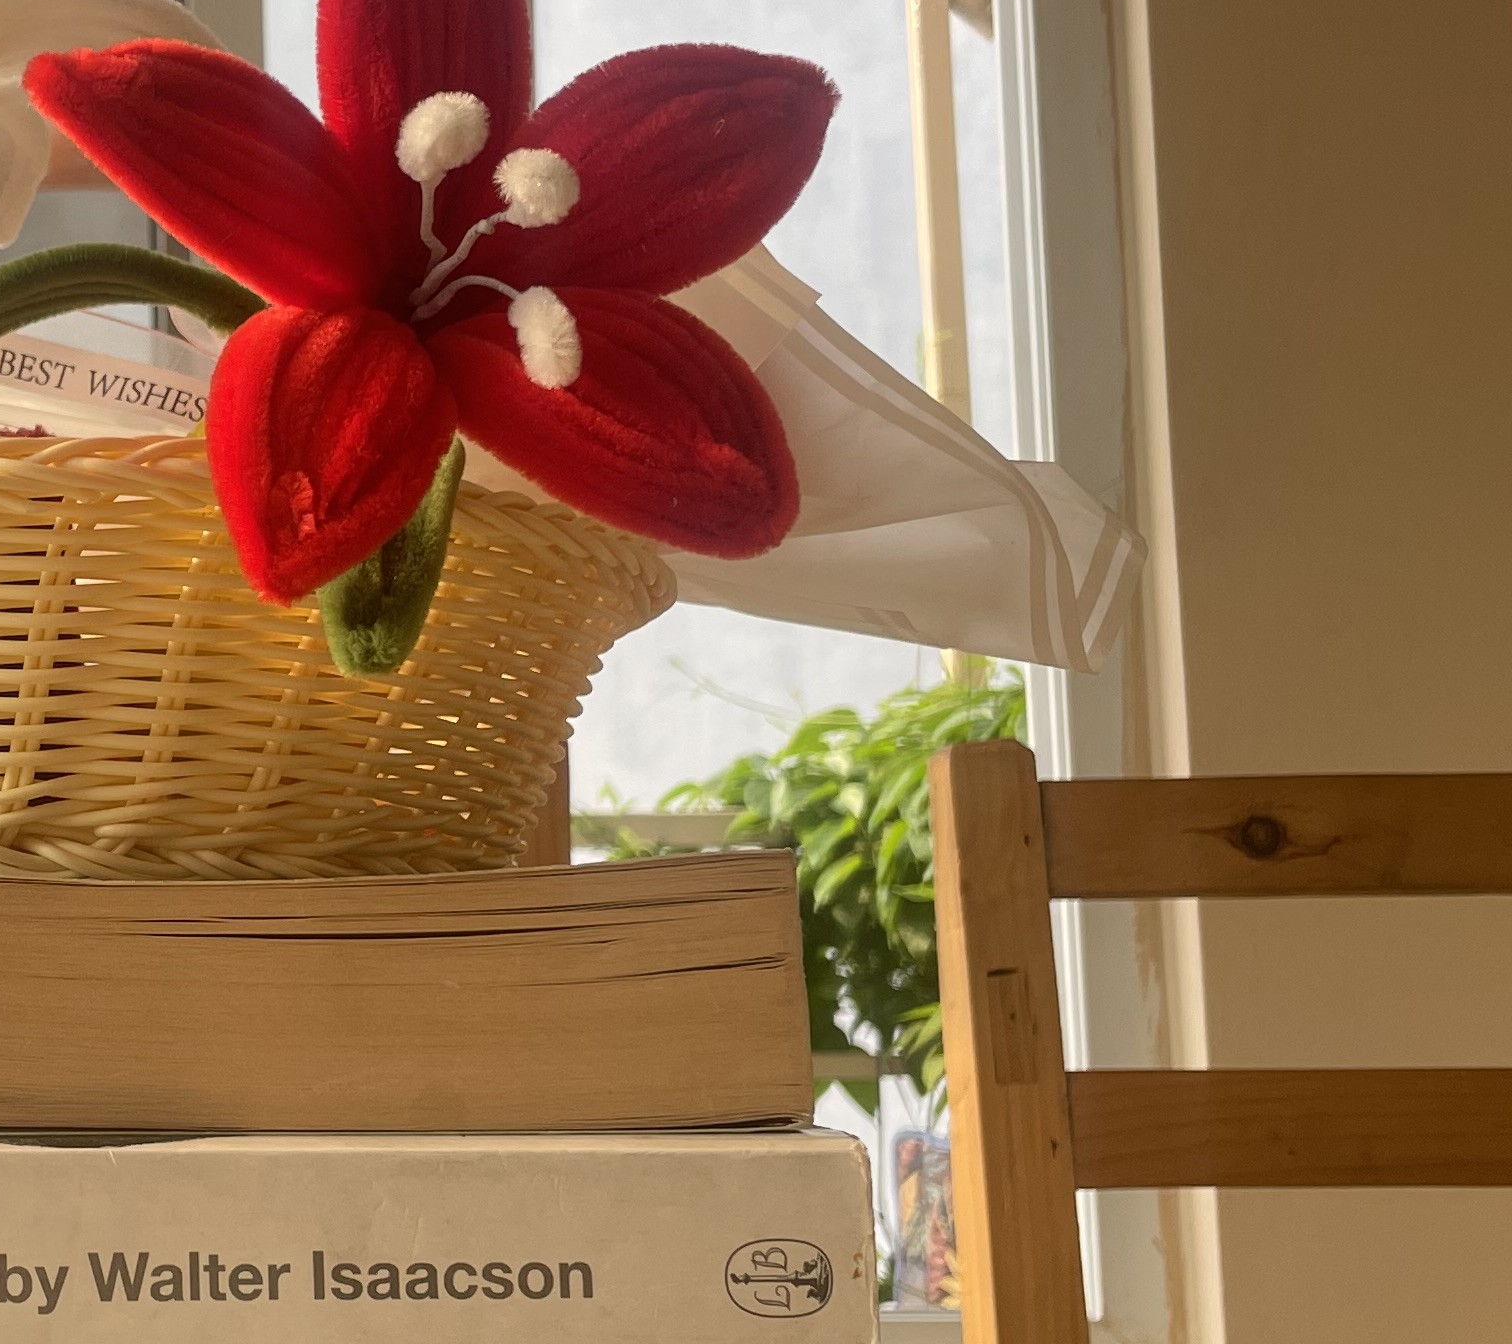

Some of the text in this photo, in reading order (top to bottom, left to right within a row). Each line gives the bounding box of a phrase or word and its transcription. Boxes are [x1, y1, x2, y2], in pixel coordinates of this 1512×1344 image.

[90, 369, 207, 423] WISHES
[88, 1252, 290, 1301] Walter
[313, 1251, 593, 1300] Isaacson
